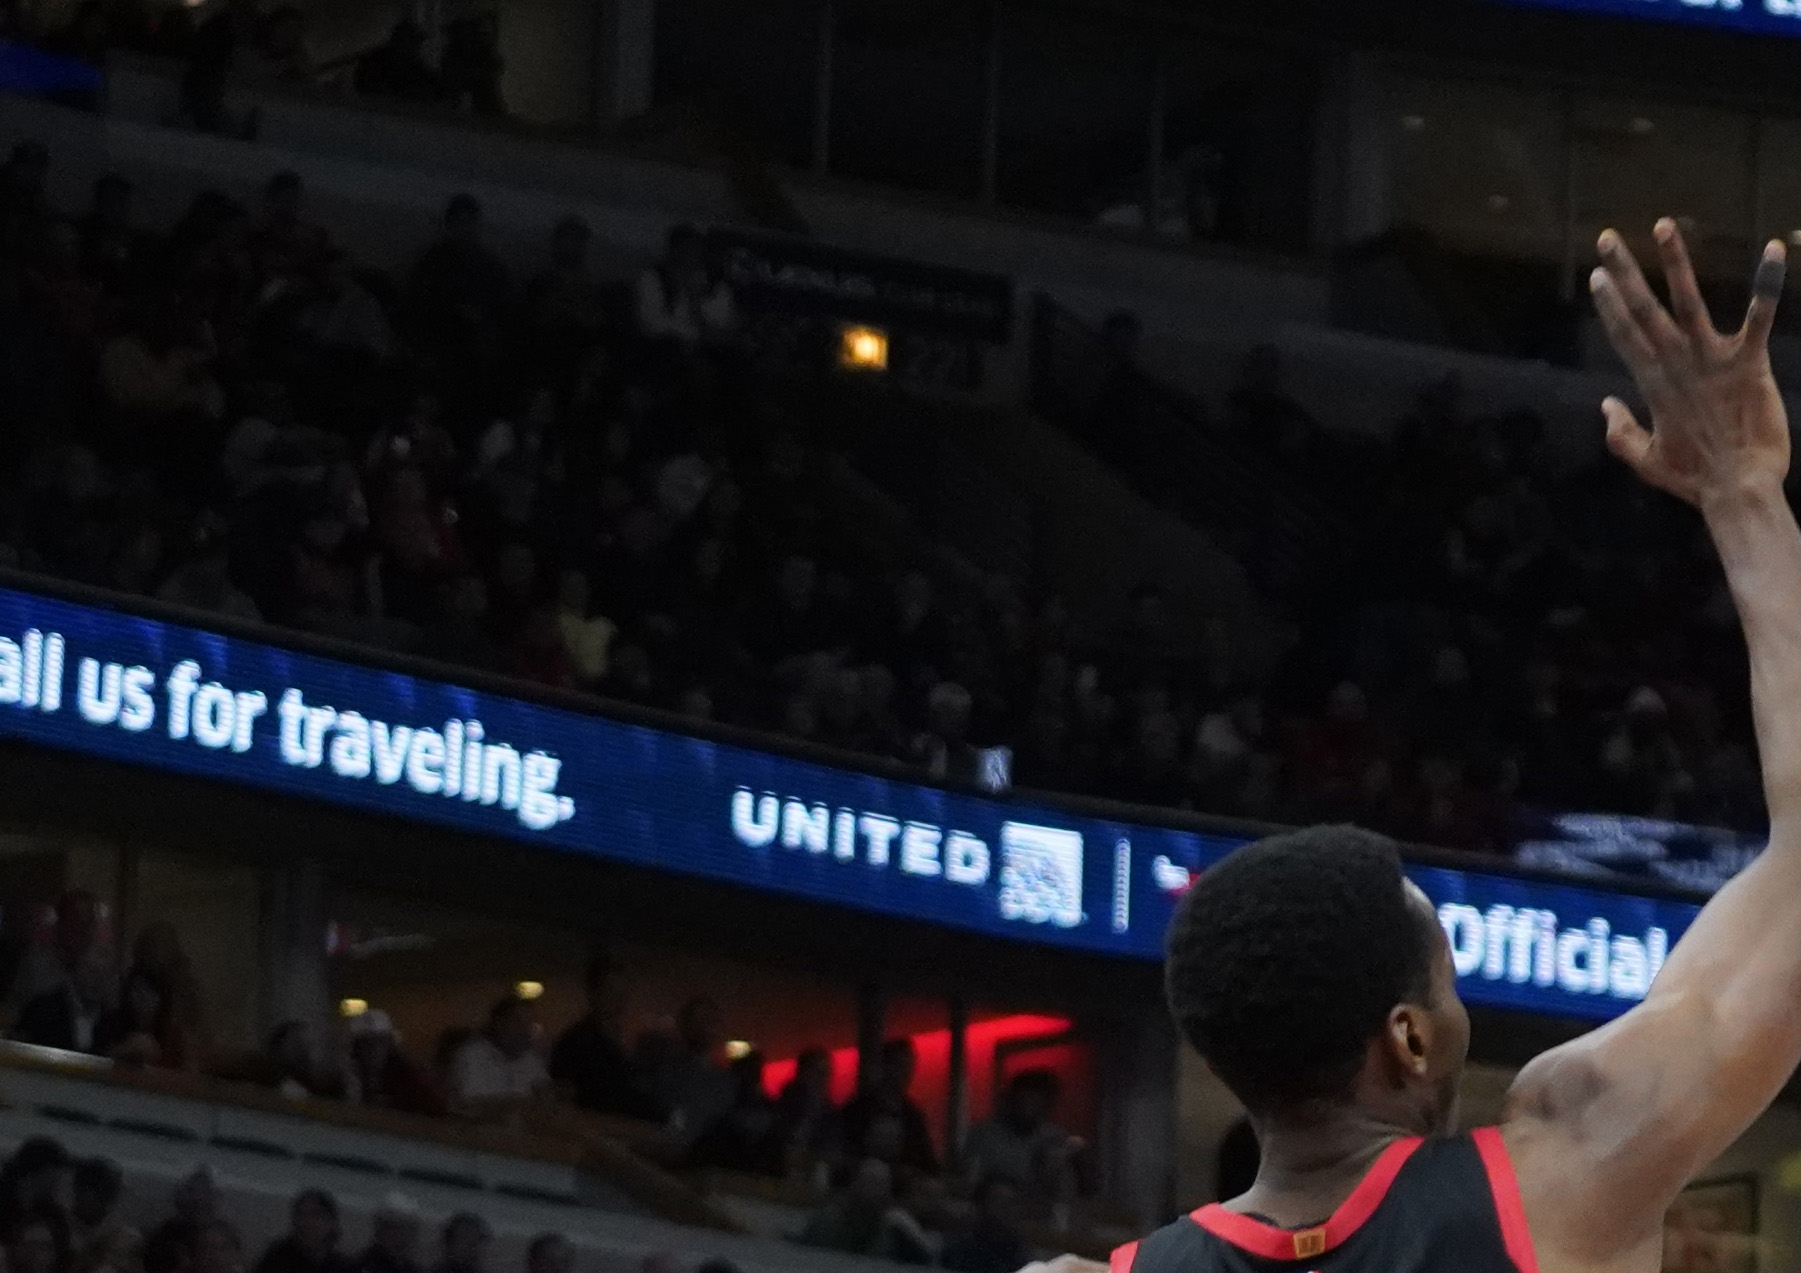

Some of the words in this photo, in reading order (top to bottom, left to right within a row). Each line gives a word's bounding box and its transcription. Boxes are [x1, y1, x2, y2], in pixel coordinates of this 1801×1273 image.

[78, 657, 156, 731] us
[166, 660, 268, 753] for
[278, 687, 576, 829] traveling.
[731, 785, 991, 887] UNITED
